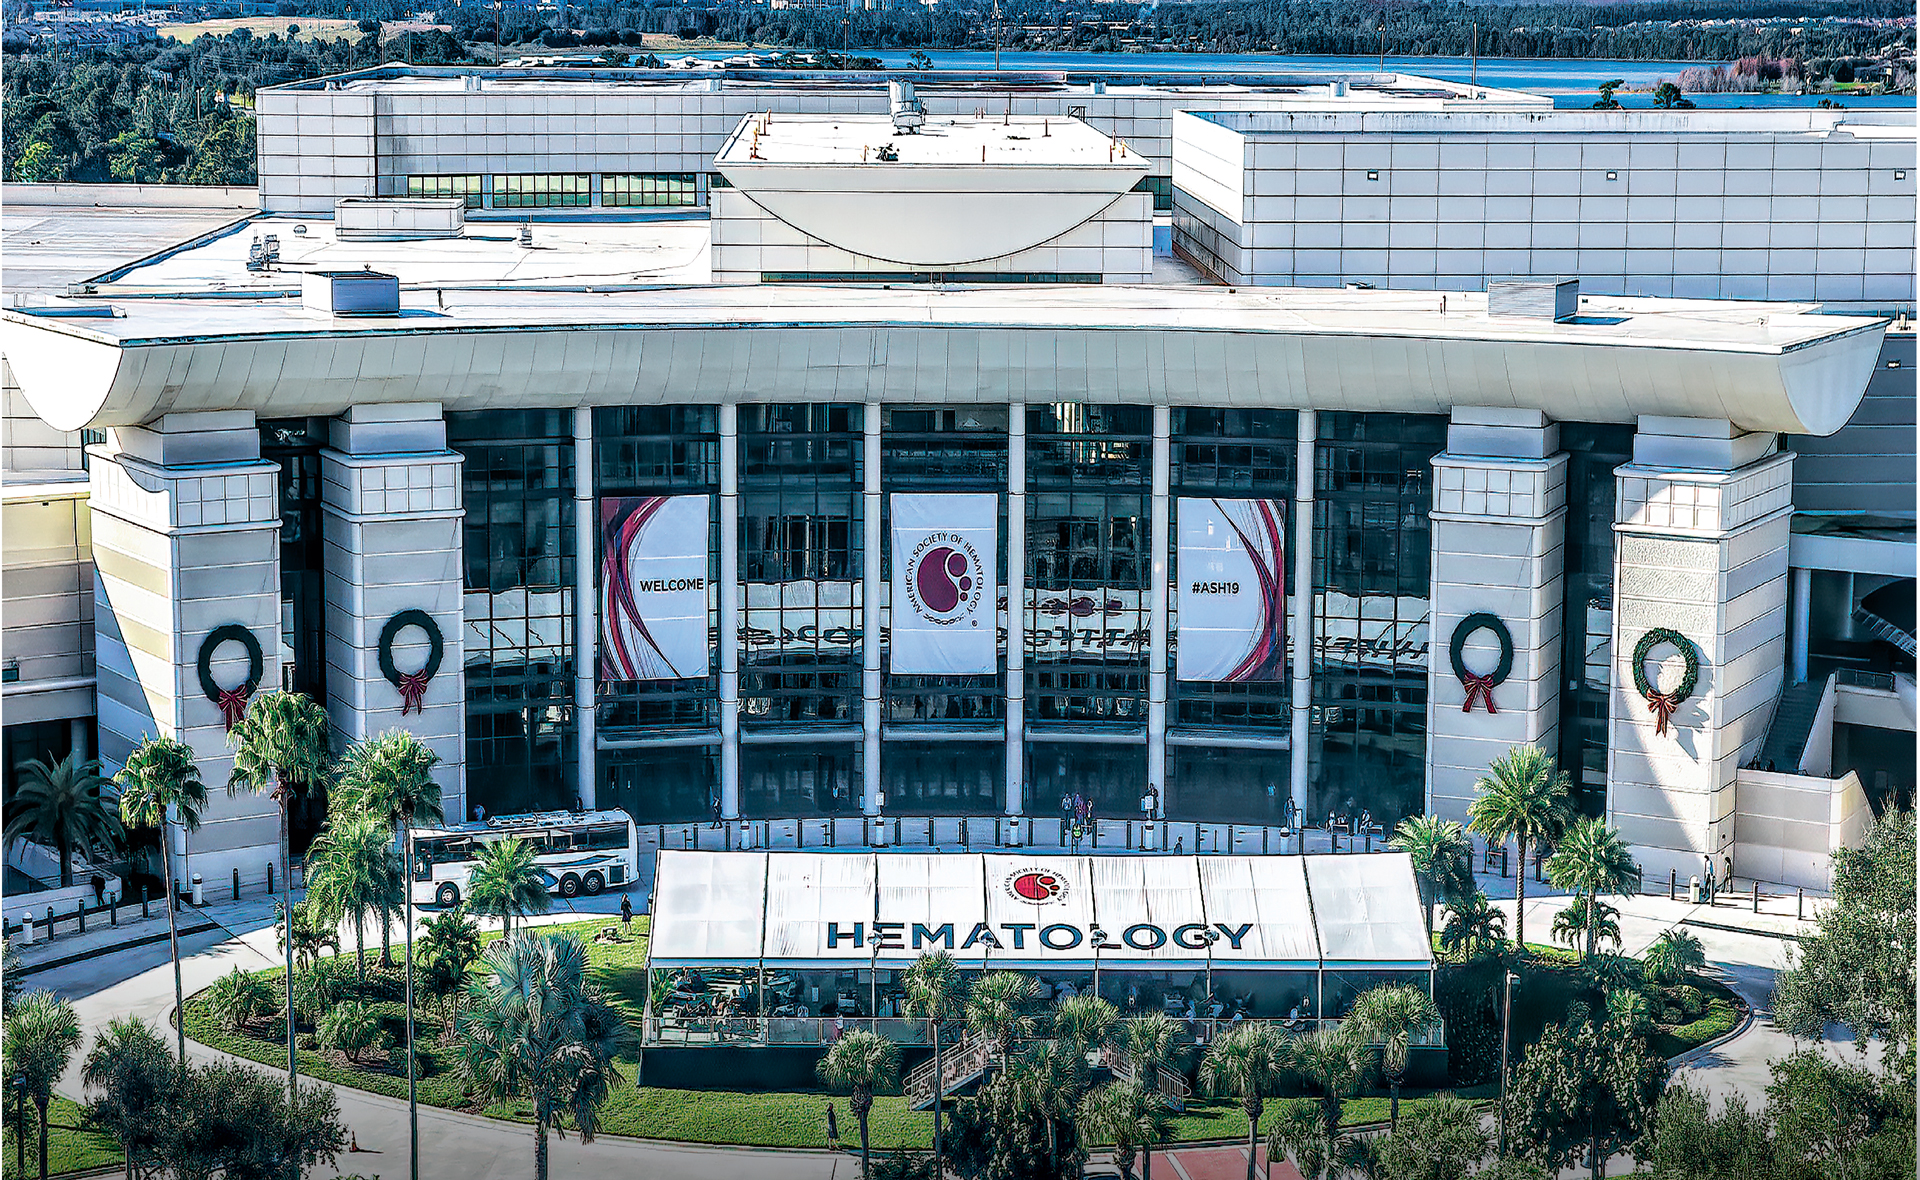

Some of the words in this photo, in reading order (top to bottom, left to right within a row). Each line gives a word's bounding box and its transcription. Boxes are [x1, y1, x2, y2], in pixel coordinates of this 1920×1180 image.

[912, 532, 948, 558] SOCIETY
[950, 534, 963, 545] OF
[639, 579, 704, 592] WELCOME
[905, 558, 923, 613] AMERICAN
[963, 542, 984, 615] HEMATOLOGY
[1192, 582, 1240, 594] #ASH19
[827, 922, 1254, 950] HEMATOLOGY
